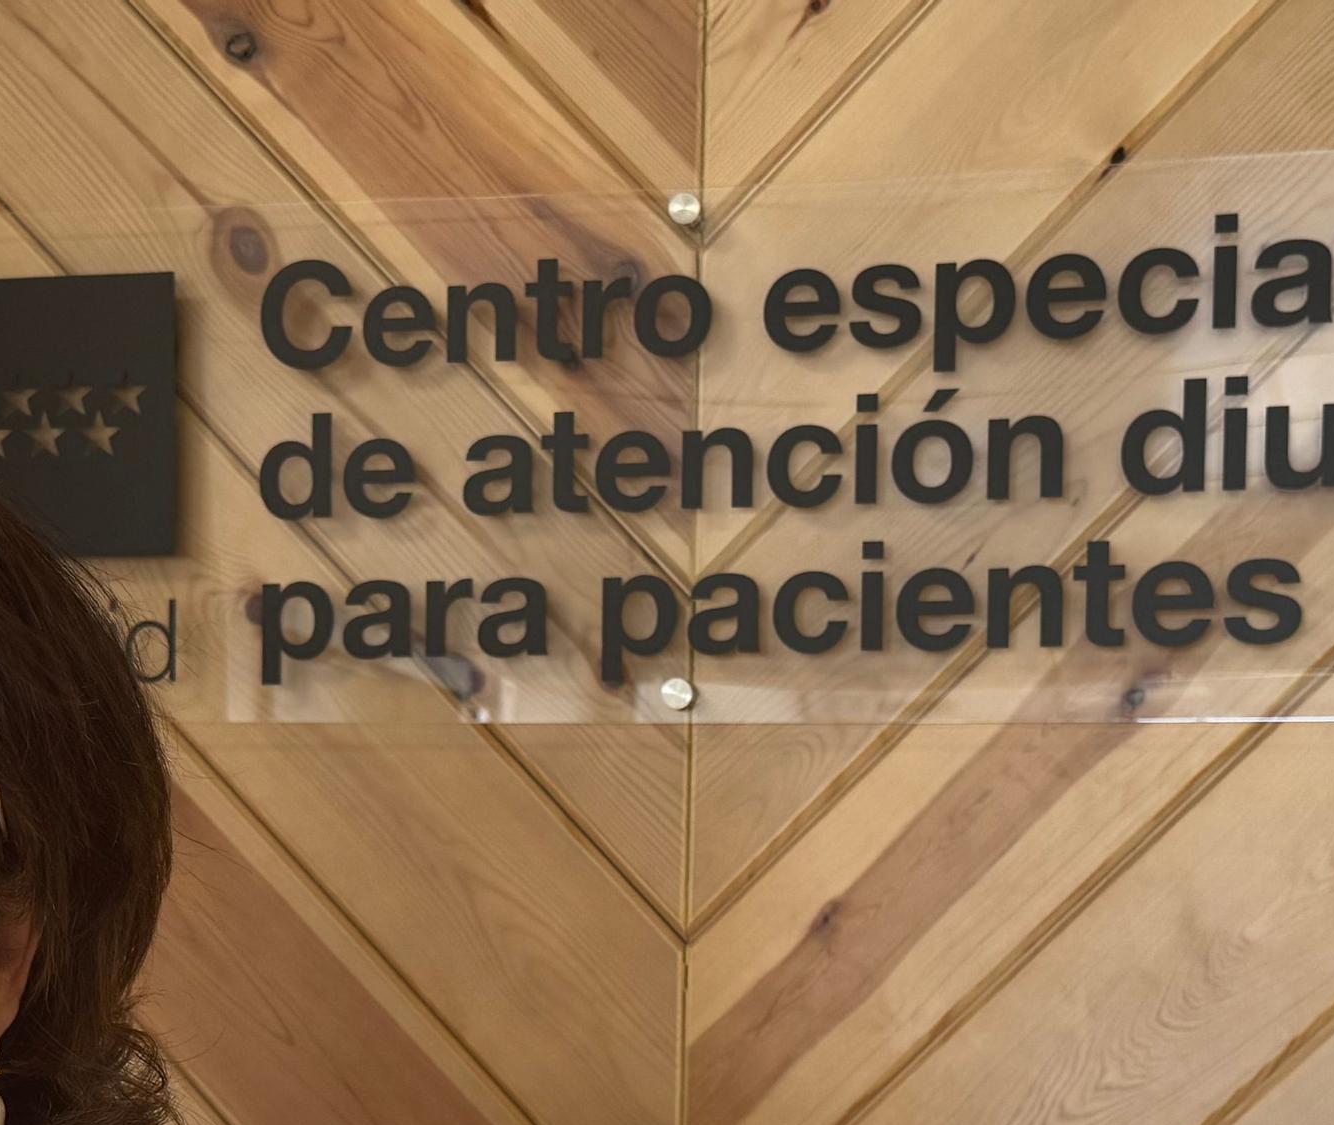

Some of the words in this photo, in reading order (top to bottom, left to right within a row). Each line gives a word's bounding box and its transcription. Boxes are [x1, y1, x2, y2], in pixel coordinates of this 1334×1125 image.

[260, 259, 712, 371] Centro
[260, 413, 415, 519] de
[465, 389, 1064, 515] atención
[261, 575, 547, 685] para
[601, 540, 1303, 684] pacientes
